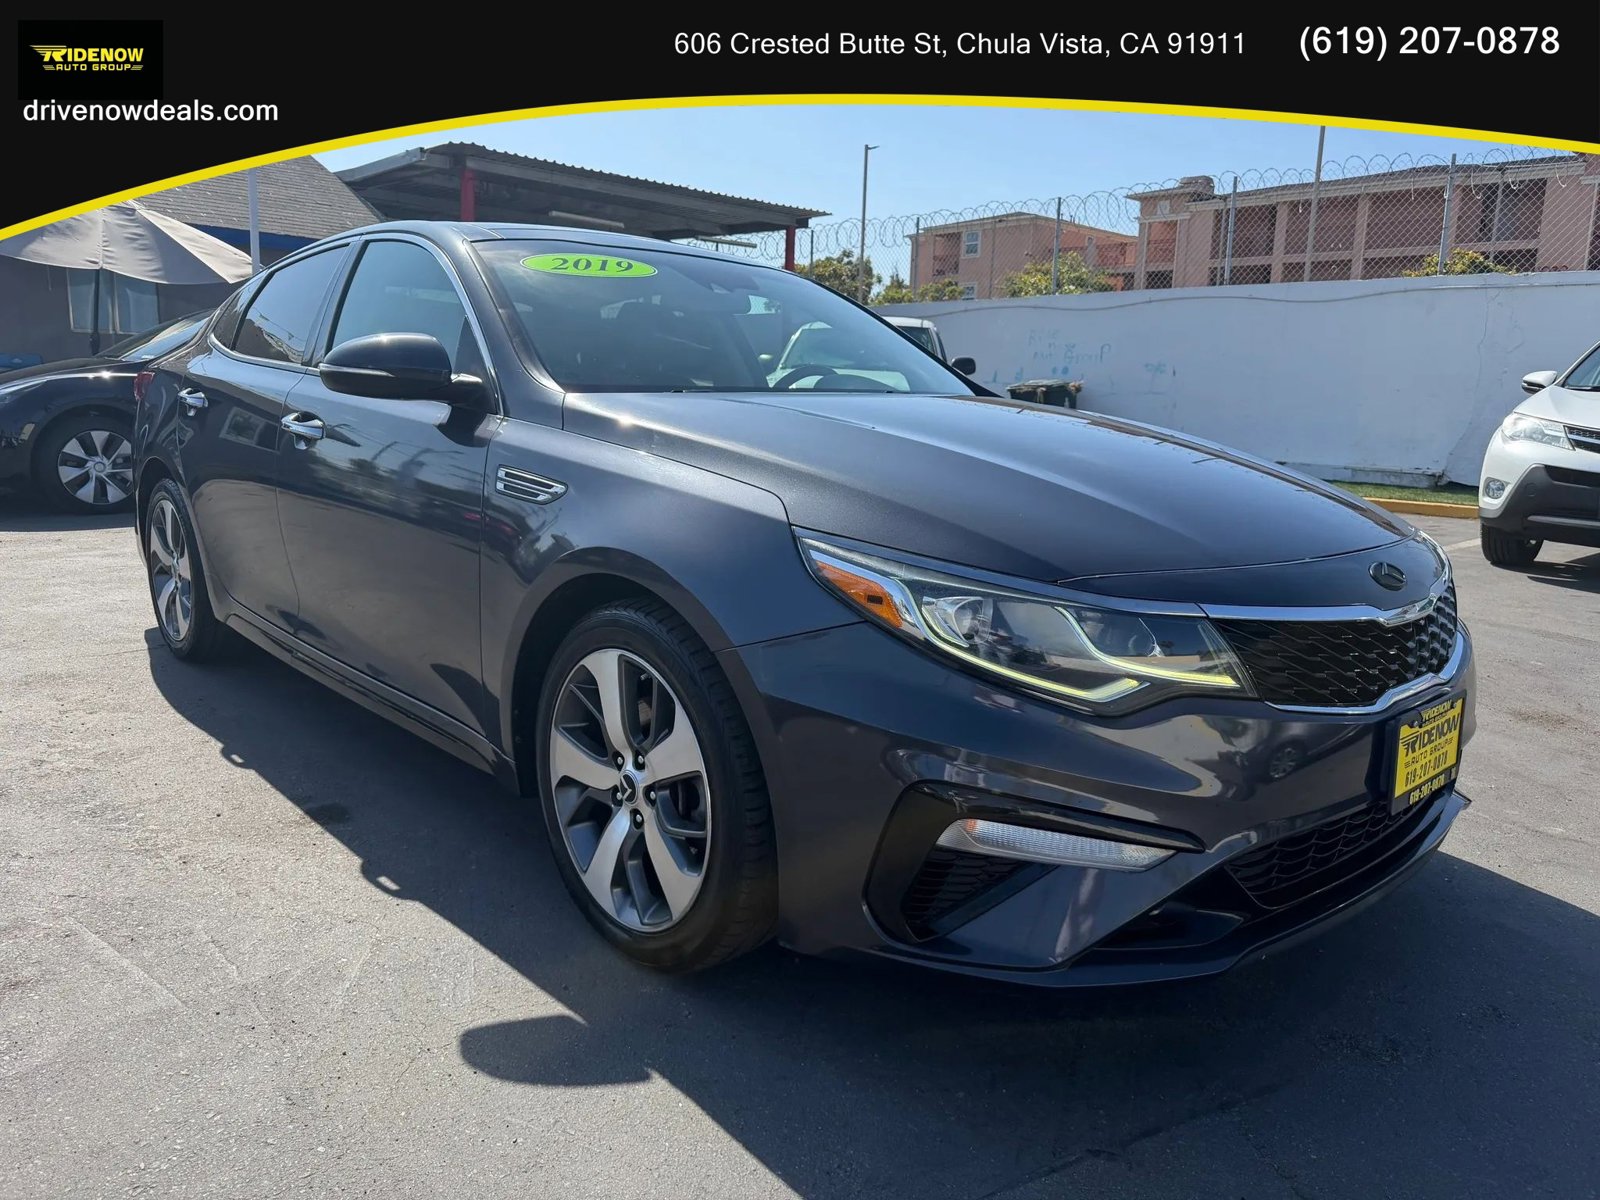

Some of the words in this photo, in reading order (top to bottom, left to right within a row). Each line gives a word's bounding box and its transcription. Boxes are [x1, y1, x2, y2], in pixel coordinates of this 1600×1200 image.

[551, 257, 634, 273] 2019
[1400, 713, 1460, 757] RIDENOW
[1405, 750, 1448, 787] 619-207-0878
[1410, 749, 1428, 768] AUTO
